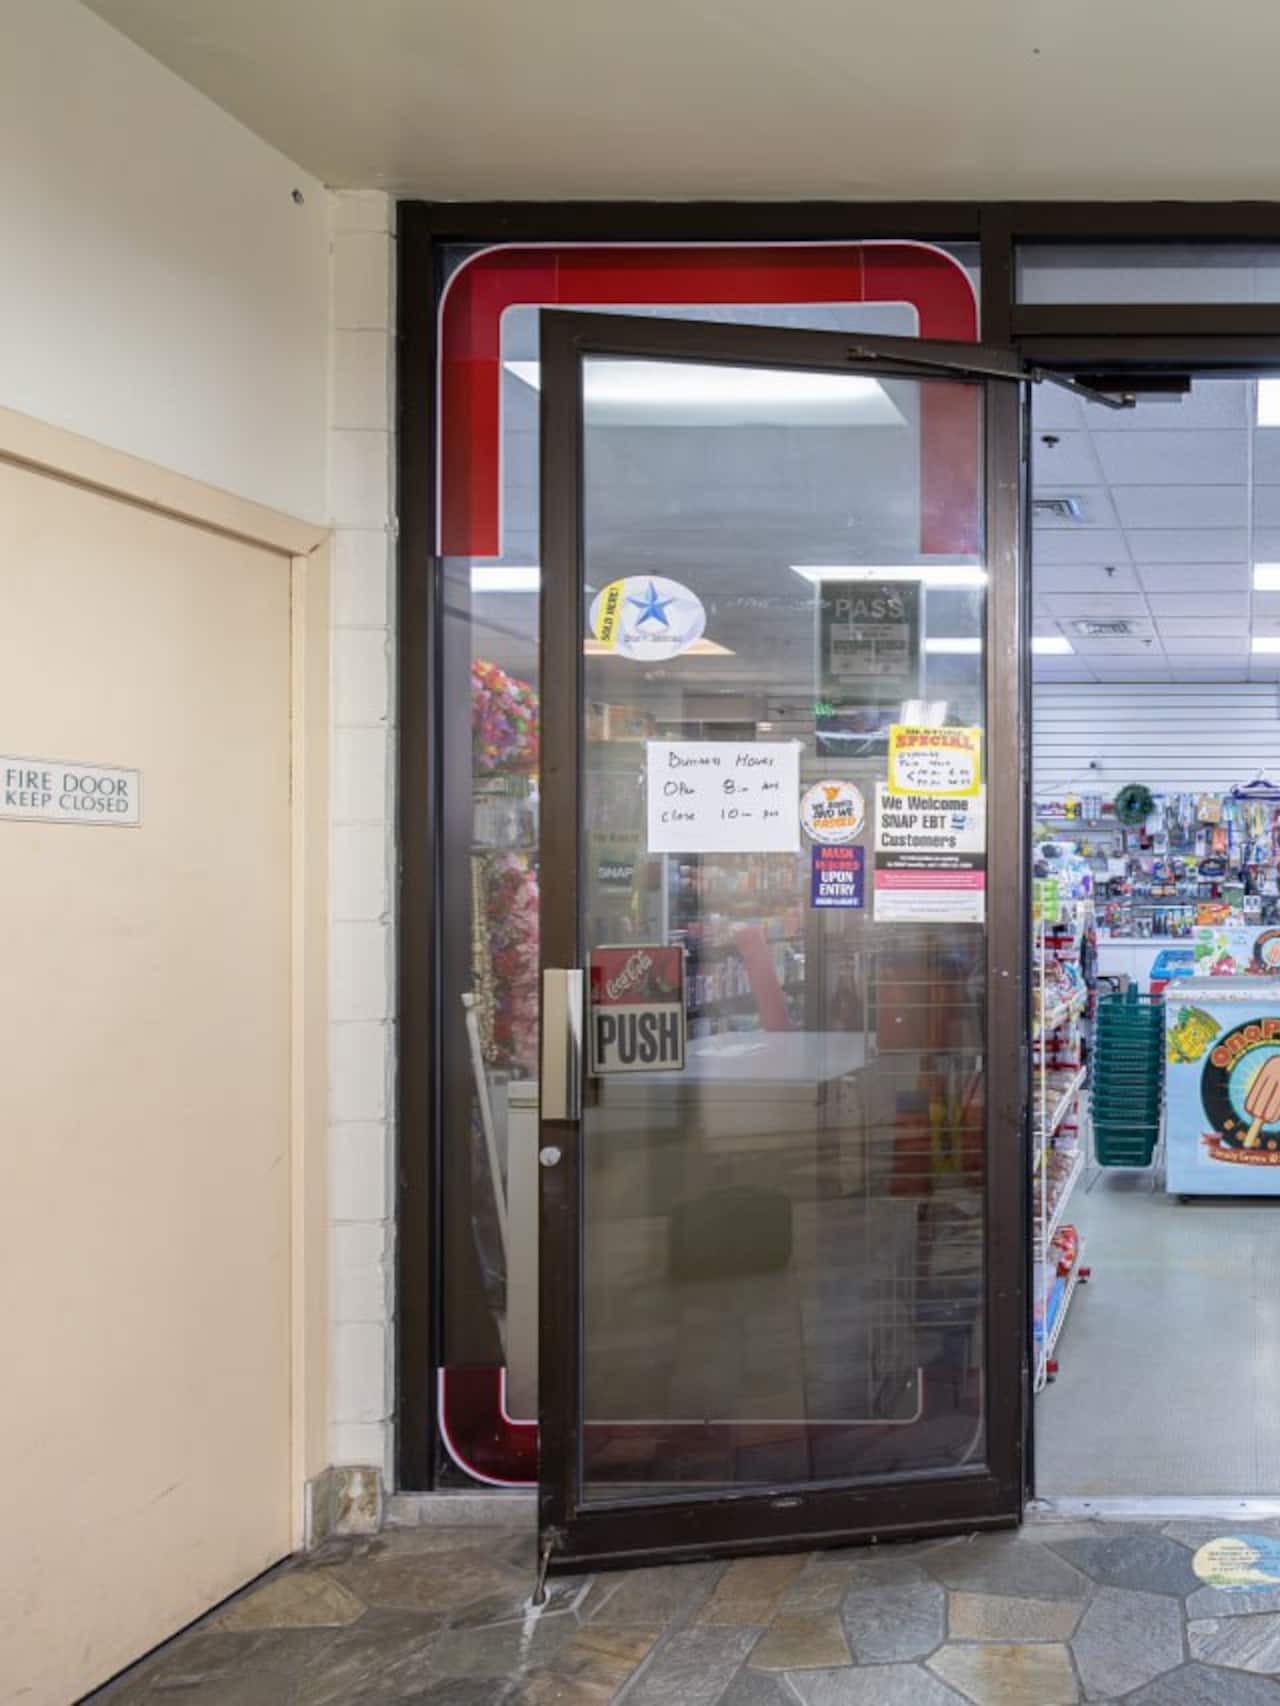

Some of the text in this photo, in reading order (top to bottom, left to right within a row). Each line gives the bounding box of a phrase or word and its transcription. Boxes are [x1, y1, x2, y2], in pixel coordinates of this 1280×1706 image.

[835, 599, 904, 618] PASS
[895, 735, 975, 749] SPECIAL
[5, 768, 129, 797] FIRE DOOR
[5, 790, 129, 813] KEEP CLOSED
[881, 796, 969, 811] We Welcome
[881, 813, 918, 829] SNAP
[922, 815, 946, 829] EBT
[881, 832, 957, 848] Customers
[820, 871, 854, 882] UPON
[819, 884, 856, 896] ENTRY
[596, 1011, 680, 1065] PUSH
